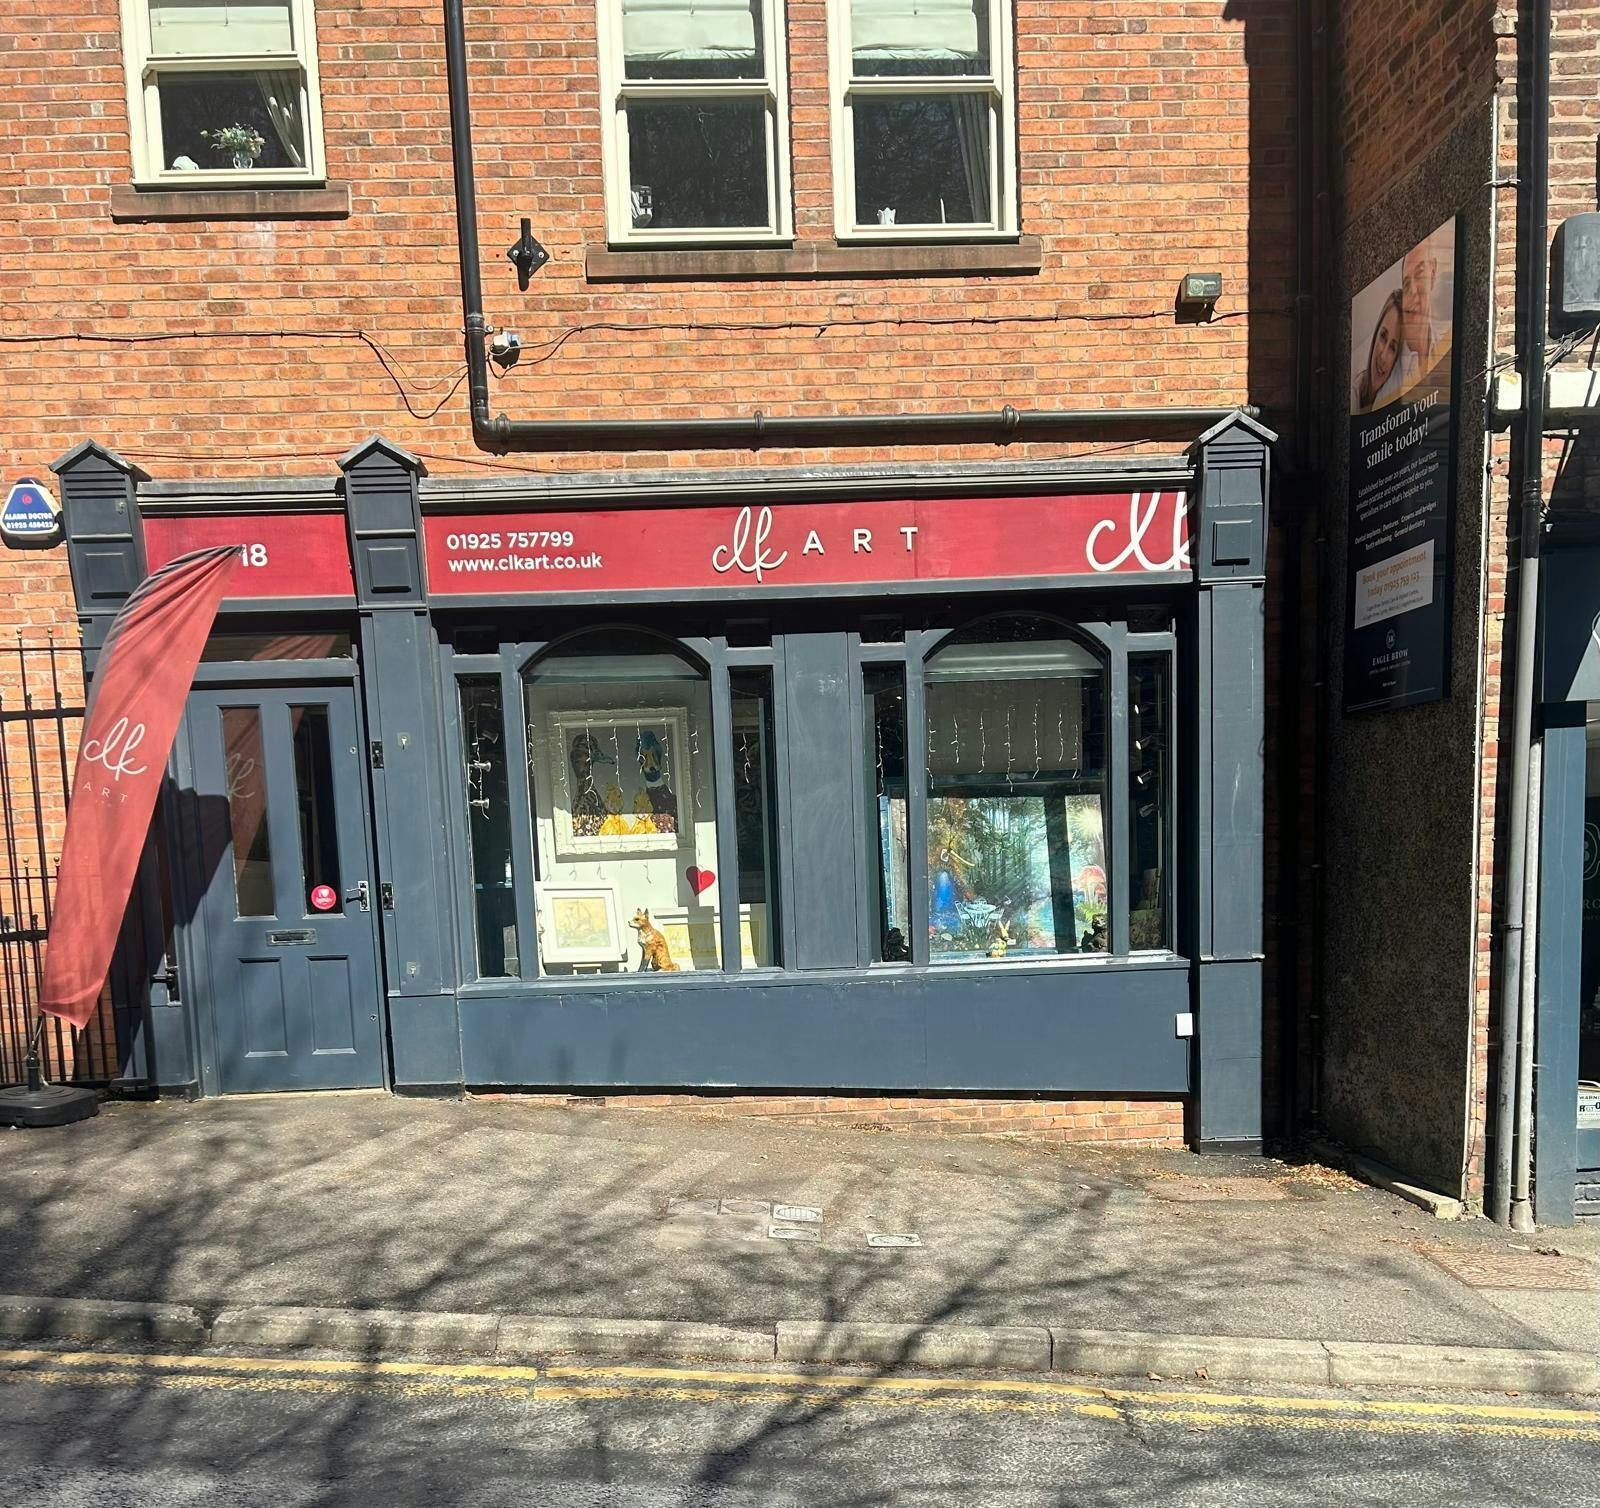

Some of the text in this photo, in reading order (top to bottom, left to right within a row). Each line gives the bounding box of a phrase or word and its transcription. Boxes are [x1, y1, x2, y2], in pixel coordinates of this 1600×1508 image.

[1360, 390, 1438, 448] Transform your
[1367, 417, 1428, 469] smile today!
[1359, 480, 1378, 498] Established
[1369, 491, 1384, 505] practice
[1392, 472, 1414, 492] experienced
[1415, 466, 1427, 480] dental
[1401, 512, 1415, 522] Crowns
[446, 531, 574, 550] 01925 757799
[712, 506, 918, 582] clk ART
[242, 543, 268, 567] 18
[448, 552, 602, 572] www.clkart.co.uk
[1376, 567, 1389, 581] your
[1390, 551, 1426, 575] appointment
[83, 716, 148, 781] clk
[82, 781, 128, 803] ART
